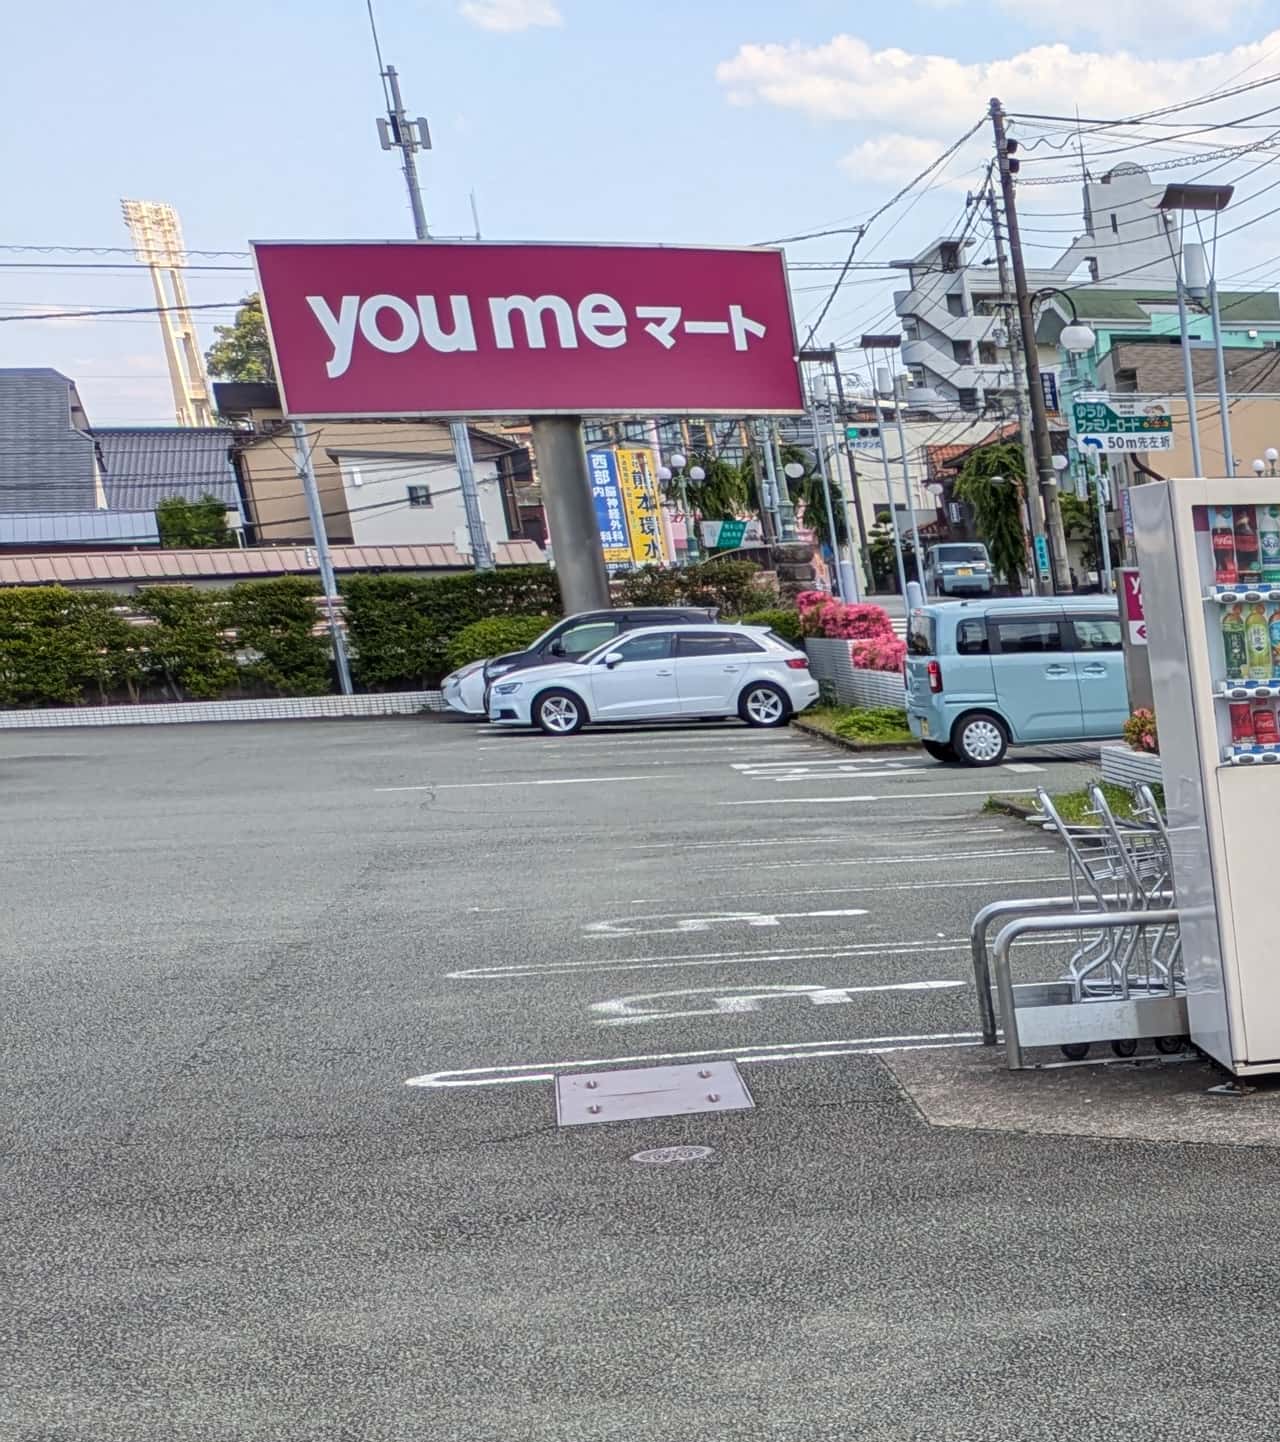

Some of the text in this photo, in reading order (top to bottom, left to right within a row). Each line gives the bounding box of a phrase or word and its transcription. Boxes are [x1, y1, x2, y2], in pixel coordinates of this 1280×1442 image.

[305, 293, 766, 378] you me マート
[1077, 418, 1140, 432] ファミリーロード
[1107, 436, 1170, 449] 50m先左折
[591, 454, 611, 485] 西部
